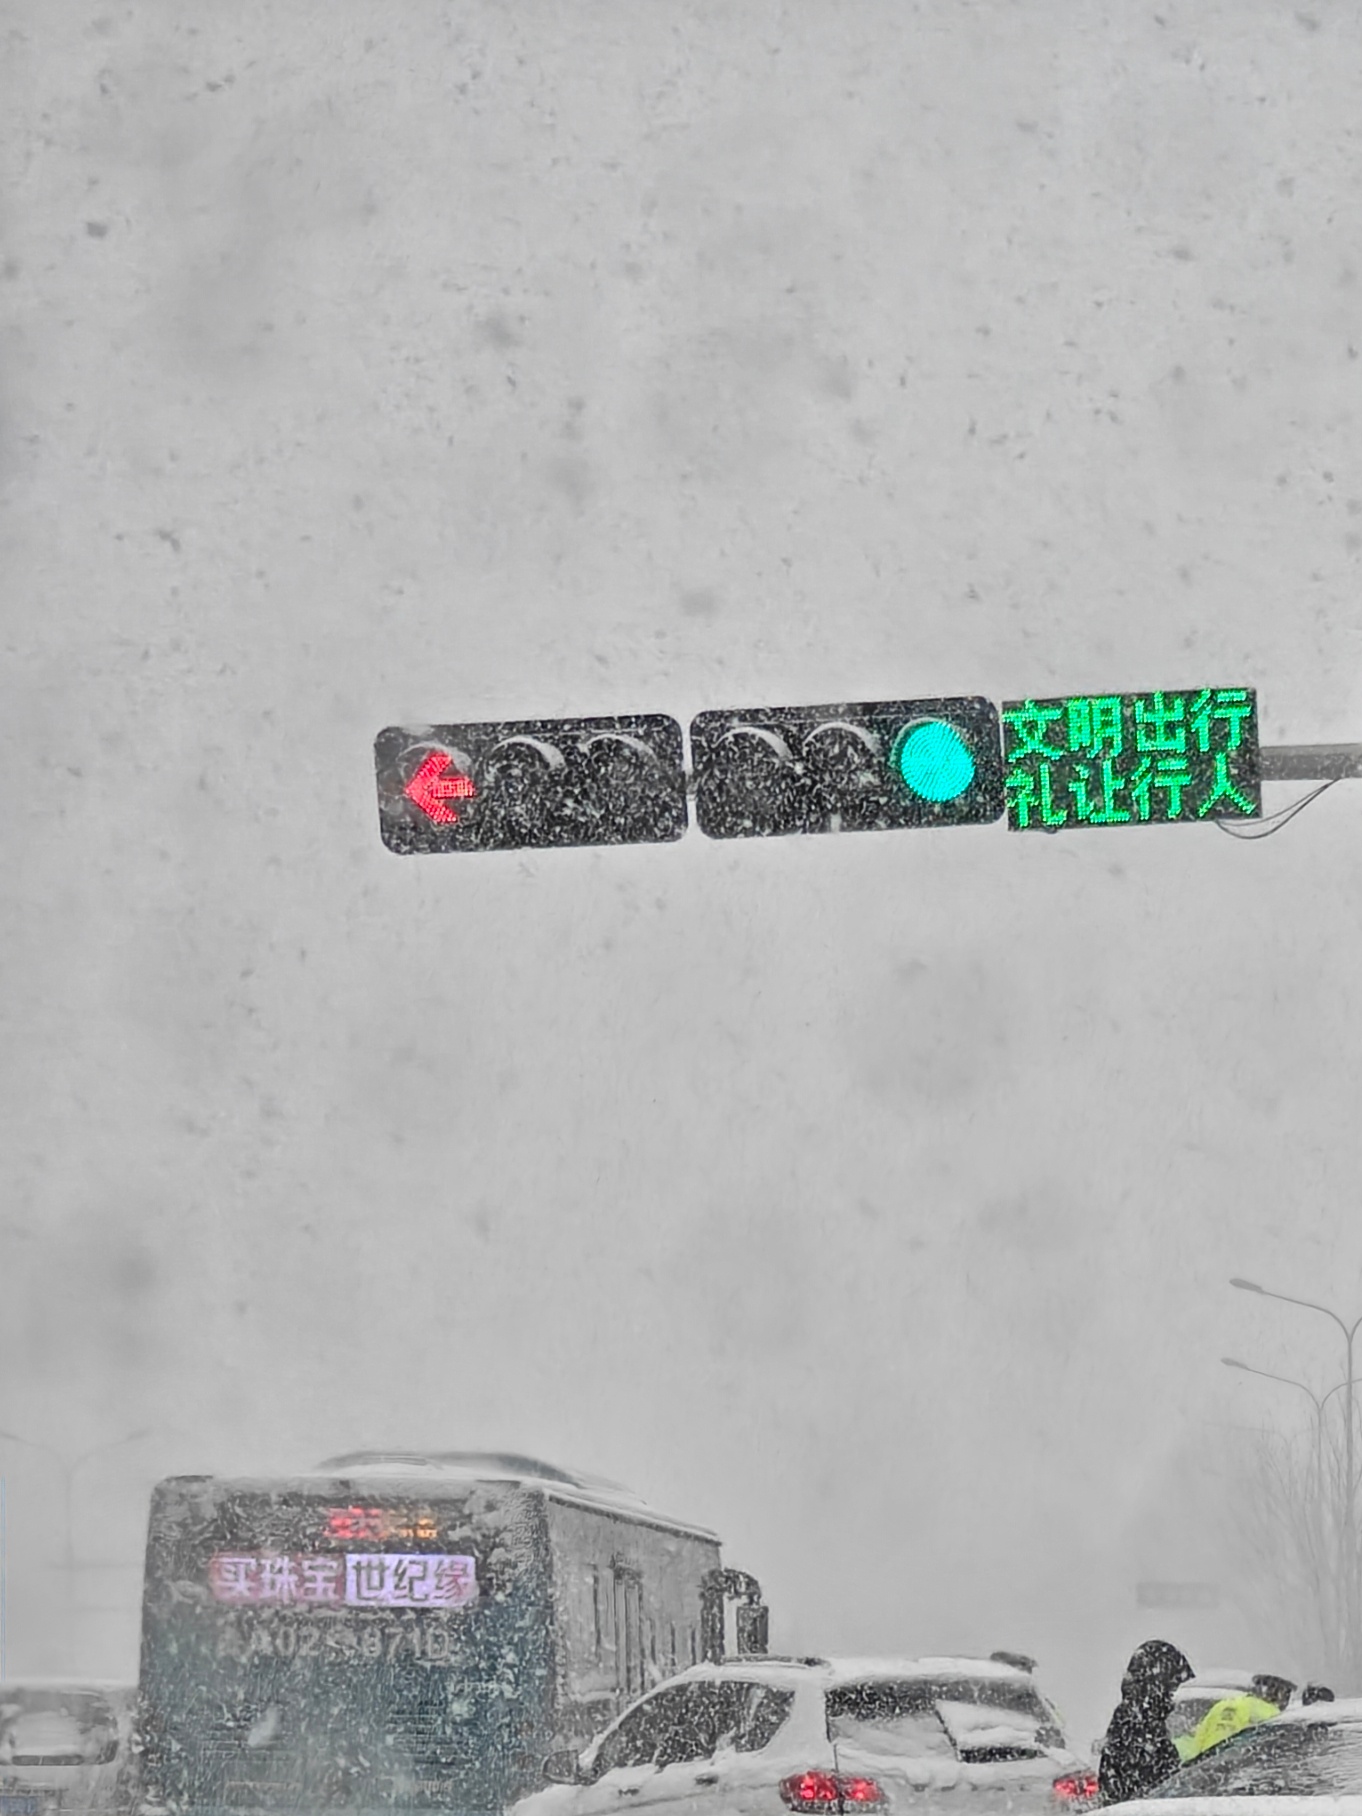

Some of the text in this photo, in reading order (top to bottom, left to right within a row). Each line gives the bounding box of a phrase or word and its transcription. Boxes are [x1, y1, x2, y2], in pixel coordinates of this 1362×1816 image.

[1001, 688, 1252, 762] 文明出行
[1005, 752, 1257, 828] 礼让行人
